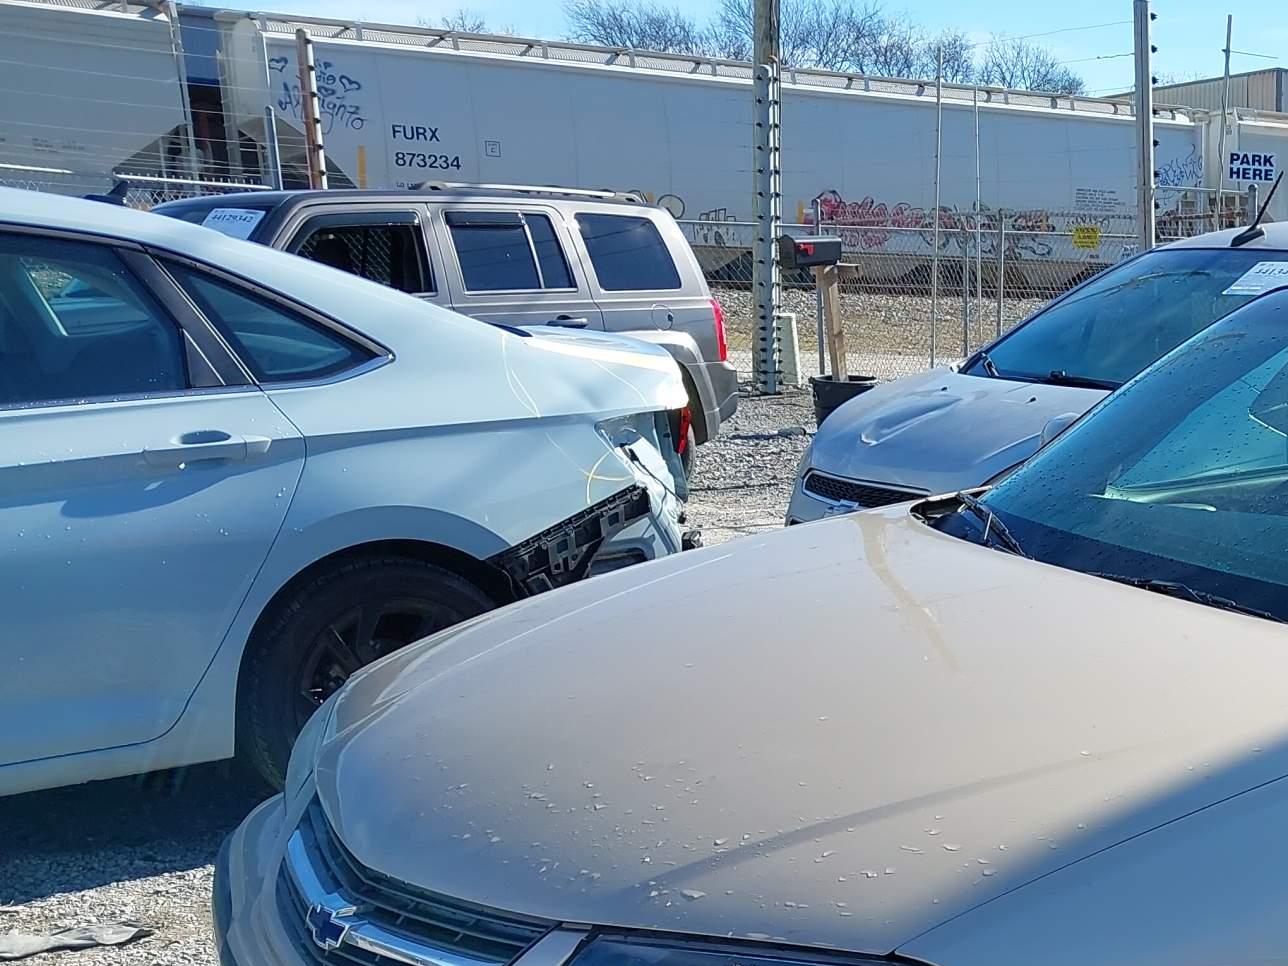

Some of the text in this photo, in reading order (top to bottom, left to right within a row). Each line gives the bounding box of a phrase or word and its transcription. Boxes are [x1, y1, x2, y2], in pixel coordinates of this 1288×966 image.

[391, 124, 441, 143] FURX
[395, 151, 462, 171] 873234
[1229, 152, 1274, 167] PARK
[1229, 167, 1274, 181] HERE
